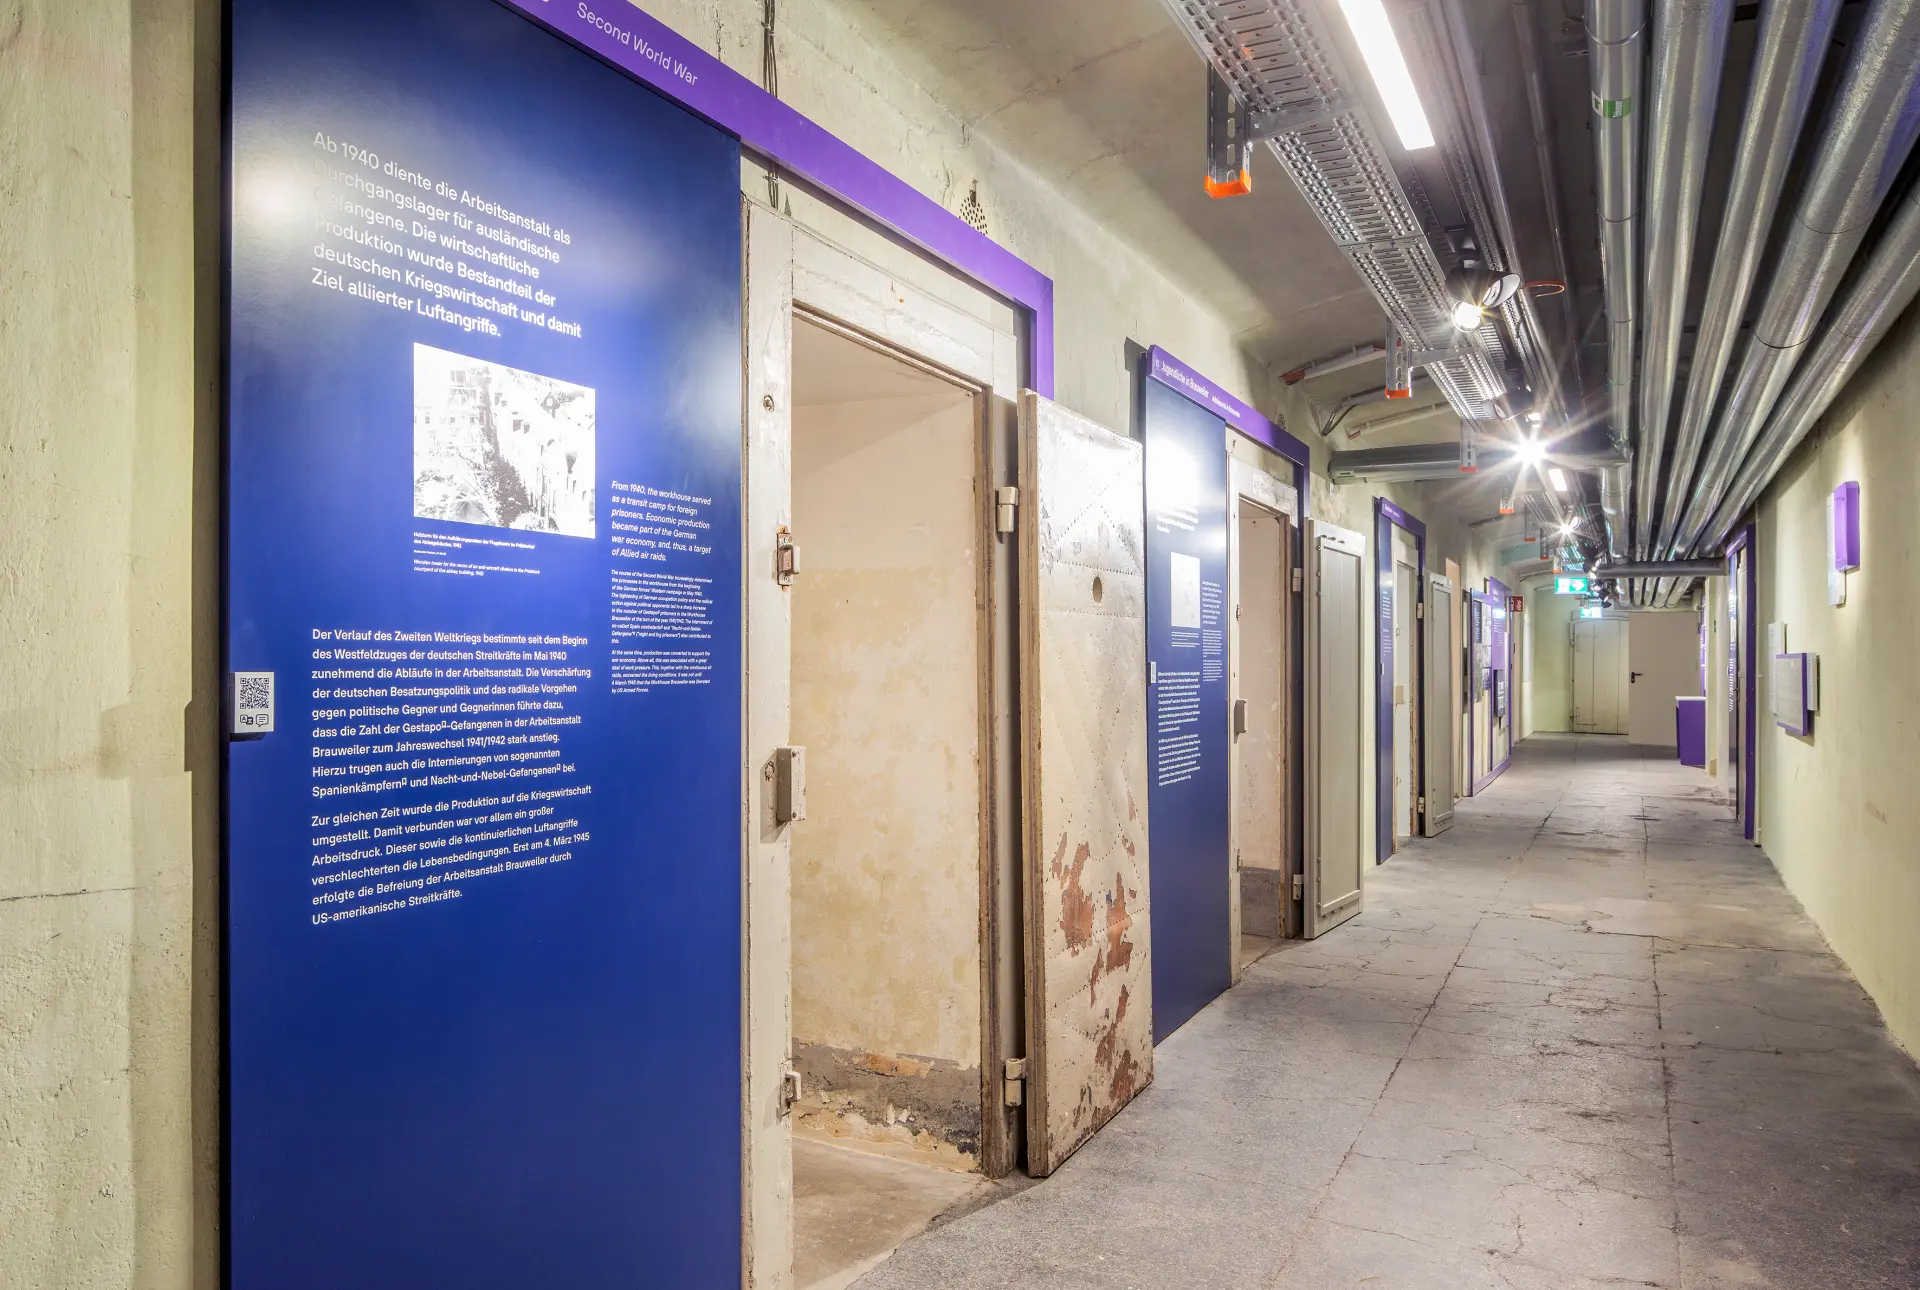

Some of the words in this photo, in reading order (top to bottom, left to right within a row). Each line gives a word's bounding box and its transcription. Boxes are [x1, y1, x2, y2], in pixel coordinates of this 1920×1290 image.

[576, 2, 630, 45] Second
[633, 35, 672, 70] World
[673, 59, 698, 86] War
[313, 131, 337, 153] Ab
[342, 143, 379, 169] 1940
[384, 161, 431, 191] diente
[435, 180, 457, 200] die
[461, 191, 550, 236] Arbeitsanstalt
[553, 229, 570, 244] als
[313, 160, 449, 220] Durchgangslager
[453, 212, 473, 231] für
[476, 224, 559, 263] ausländische
[313, 186, 407, 232] Gefangene.
[412, 220, 436, 242] Die
[440, 235, 539, 281] wirtschaftliche
[313, 217, 402, 257] Produktion
[407, 248, 453, 273] wurde
[457, 262, 532, 299] Bestandteil
[534, 289, 556, 309] der
[312, 268, 343, 291] Ziel
[348, 282, 413, 310] alliierter
[417, 299, 500, 339] Luftangriffe.
[313, 243, 400, 282] deutschen
[406, 271, 517, 317] Kriegswirtschaft
[520, 309, 546, 326] und
[547, 316, 581, 339] damit
[611, 480, 628, 490] From
[630, 484, 646, 494] 1940,
[647, 487, 658, 496] the
[659, 490, 691, 501] workhouse
[692, 496, 711, 505] served
[626, 497, 648, 507] transit
[648, 502, 666, 511] camp
[667, 502, 676, 511] for
[676, 505, 697, 516] foreign
[611, 508, 644, 519] prisoners.
[645, 512, 676, 524] Economic
[677, 519, 710, 529] production
[611, 520, 638, 532] became
[638, 526, 653, 534] part
[661, 528, 672, 536] the
[673, 529, 696, 539] German
[611, 547, 620, 556] of
[619, 548, 640, 558] Allied
[640, 551, 649, 559] air
[650, 552, 666, 561] raids.
[625, 537, 656, 548] economy,
[657, 541, 671, 549] and,
[672, 542, 687, 551] thus,
[693, 544, 711, 554] target
[312, 628, 332, 639] Der
[334, 629, 371, 640] Verlauf
[374, 630, 392, 640] des
[394, 630, 432, 641] Zweiten
[434, 632, 481, 644] Weltkriegs
[483, 634, 526, 643] bestimmte
[528, 634, 542, 644] seit
[543, 635, 560, 644] dem
[562, 635, 588, 646] Beginn
[312, 648, 332, 659] des
[334, 649, 407, 661] Westfeldzuges
[409, 650, 425, 659] der
[427, 650, 473, 659] deutschen
[475, 650, 520, 660] Streitkräfte
[522, 651, 532, 660] im
[534, 651, 548, 660] Mai
[549, 651, 567, 660] 1940
[312, 668, 374, 678] zunehmend
[376, 668, 392, 678] die
[395, 668, 432, 677] Abläufe
[435, 668, 443, 677] in
[445, 668, 461, 677] der
[463, 668, 523, 677] Arbeitsanstalt.
[526, 667, 539, 676] Die
[540, 667, 591, 678] Verschärfung
[312, 688, 330, 698] der
[333, 687, 387, 697] deutschen
[390, 685, 470, 697] Besatzungspolitik
[473, 685, 489, 694] und
[491, 684, 506, 694] das
[508, 684, 539, 693] radikale
[540, 684, 577, 694] Vorgehen
[312, 709, 346, 720] gegen
[349, 705, 399, 718] politische
[402, 704, 437, 716] Gegner
[439, 703, 457, 713] und
[460, 702, 515, 714] Gegnerinnen
[517, 701, 541, 710] führte
[543, 700, 563, 709] dazu,
[311, 815, 330, 826] Zur
[332, 811, 378, 826] gleichen
[380, 807, 400, 818] Zeit
[402, 804, 432, 815] wurde
[434, 801, 449, 811] die
[451, 797, 499, 809] Produktion
[501, 793, 515, 803] auf
[516, 792, 529, 801] die
[531, 785, 591, 800] Kriegswirtschaft
[312, 830, 370, 846] umgestellt.
[374, 825, 402, 837] Damit
[405, 820, 454, 833] verbunden
[456, 818, 472, 826] war
[474, 816, 488, 824] vor
[490, 812, 512, 822] allem
[514, 809, 526, 819] ein
[528, 806, 554, 819] großer
[312, 847, 382, 865] Arbeitsdruck.
[386, 843, 417, 854] Dieser
[419, 838, 446, 849] sowie
[448, 835, 462, 845] die
[465, 827, 532, 842] kontinuierlichen
[534, 819, 578, 832] Luftangriffe
[312, 865, 400, 884] verschlechterten
[402, 860, 417, 870] die
[420, 847, 510, 867] Lebensbedingungen.
[513, 842, 529, 852] Erst
[530, 841, 542, 849] am
[544, 838, 551, 847] 4.
[553, 836, 572, 846] März
[573, 832, 590, 842] 1945
[312, 890, 354, 904] erfolgte
[357, 886, 374, 897] die
[376, 879, 423, 893] Befreiung
[426, 875, 441, 884] der
[444, 863, 503, 881] Arbeitsanstalt
[505, 856, 548, 870] Brauweiler
[549, 851, 571, 862] durch
[312, 900, 405, 924] US-amerikanische
[408, 889, 462, 906] Streitkräfte.
